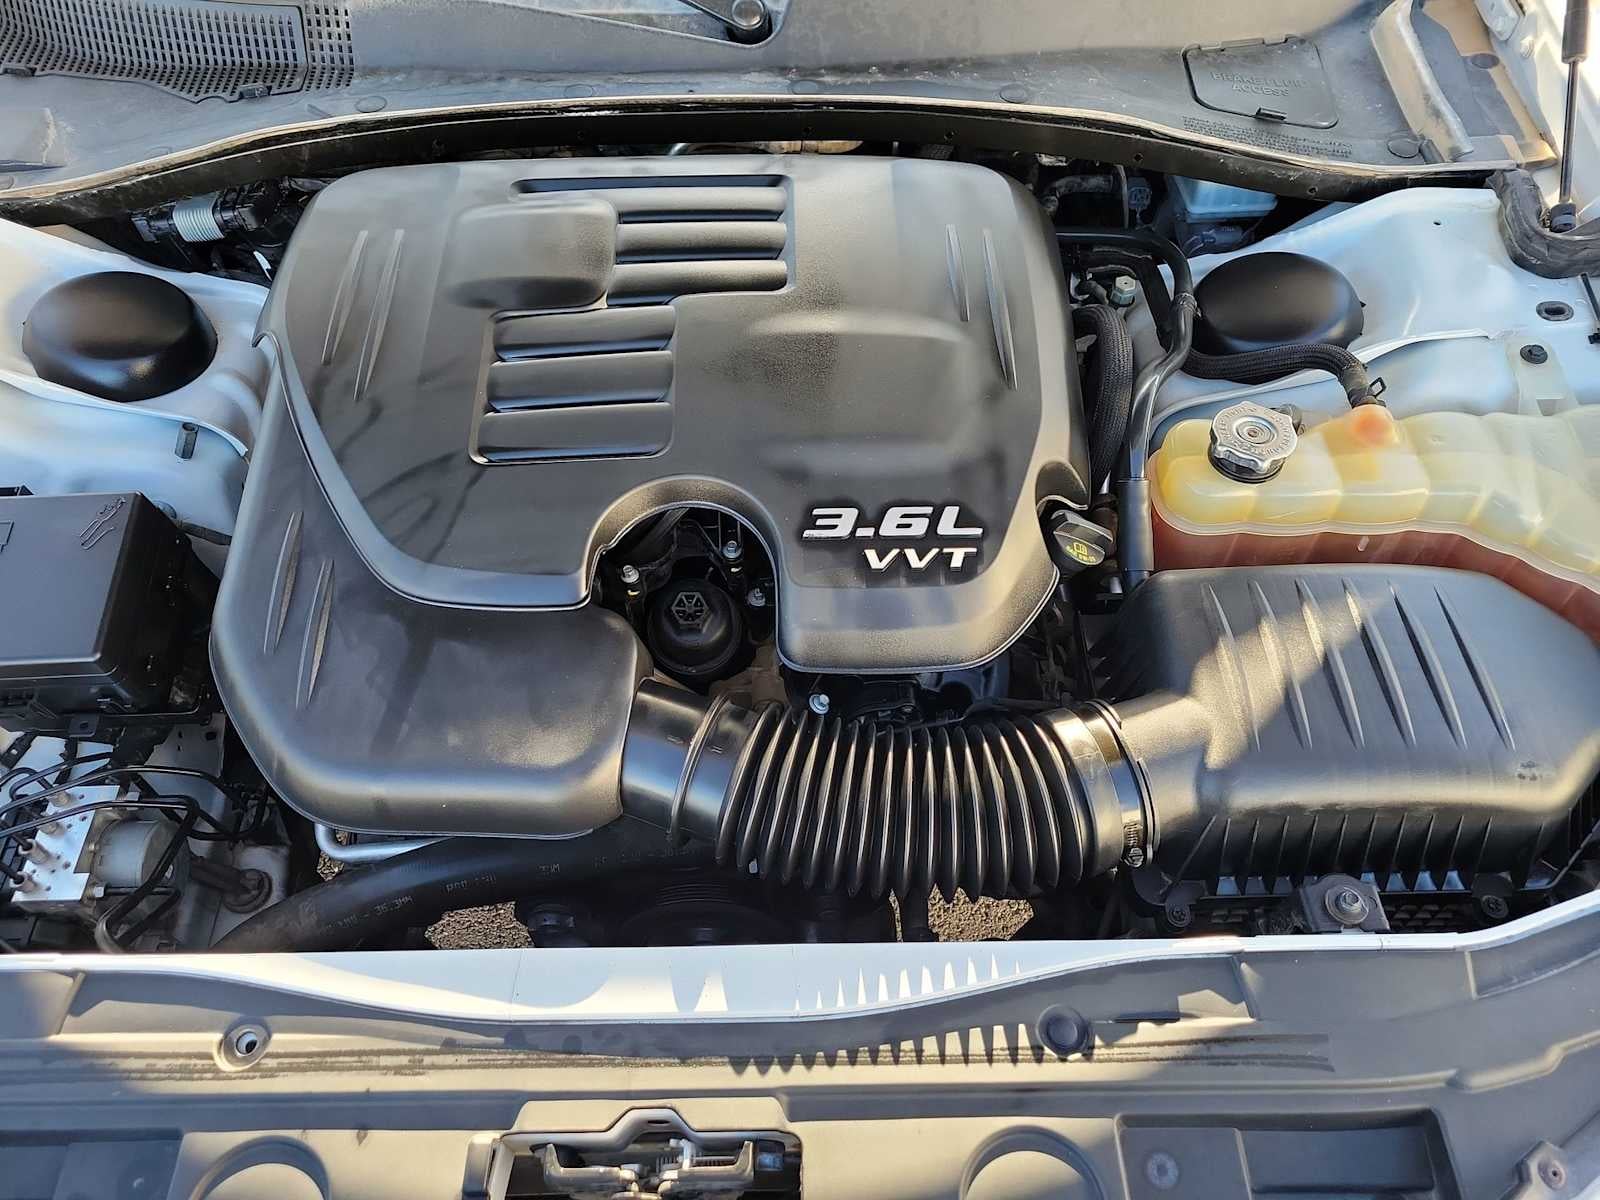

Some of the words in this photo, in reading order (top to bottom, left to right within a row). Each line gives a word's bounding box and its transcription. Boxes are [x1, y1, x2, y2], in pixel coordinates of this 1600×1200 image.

[1232, 82, 1290, 97] ACCESS
[802, 506, 984, 540] 3.6L
[864, 547, 978, 572] VVT
